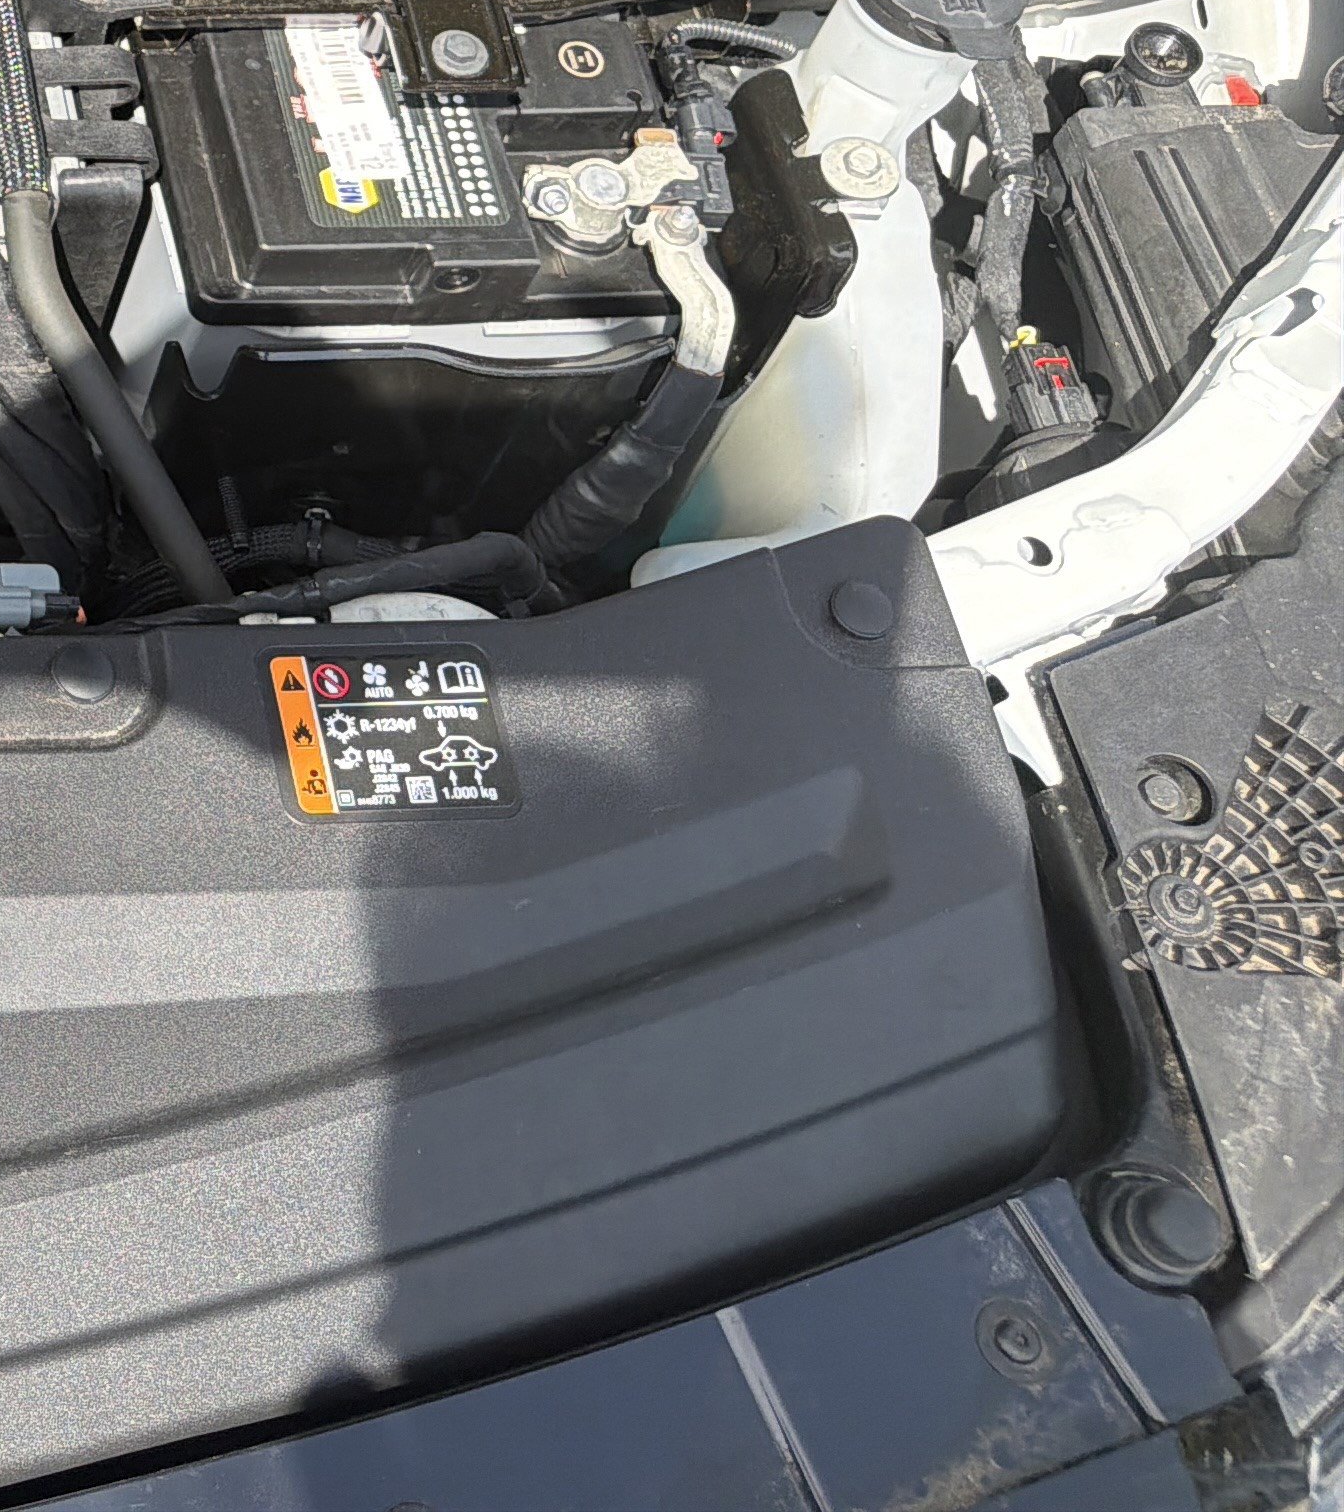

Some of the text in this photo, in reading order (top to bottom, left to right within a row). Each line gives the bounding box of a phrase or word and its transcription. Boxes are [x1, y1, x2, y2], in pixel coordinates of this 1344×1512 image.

[364, 686, 394, 698] AUTO
[422, 705, 479, 720] 0.700 kg
[359, 716, 417, 734] R-1234yf
[365, 748, 395, 764] PAG
[441, 784, 499, 800] 1.000 kg
